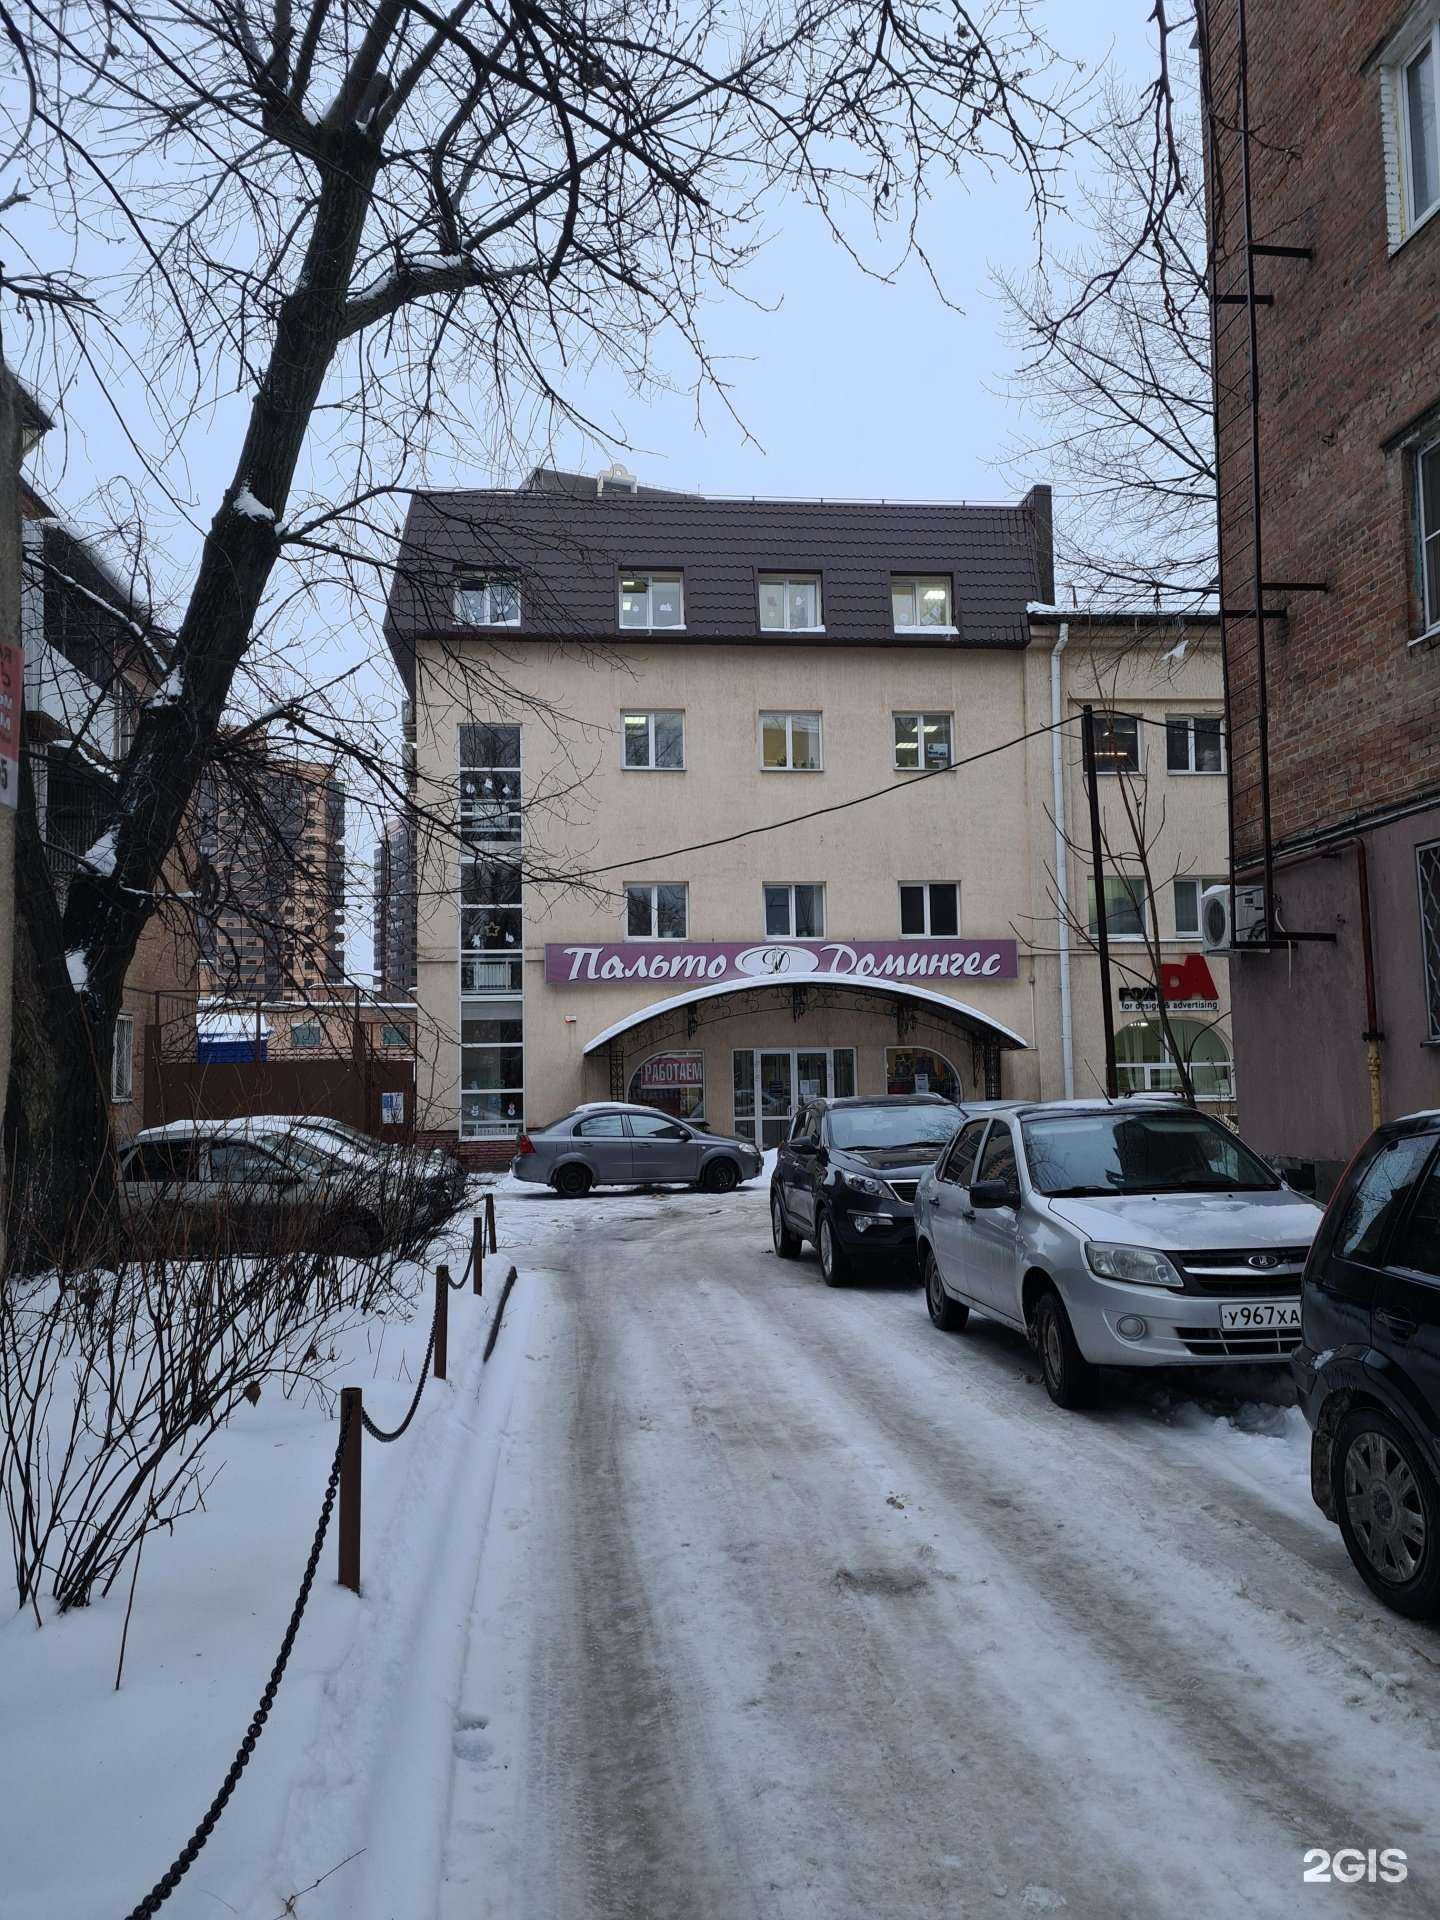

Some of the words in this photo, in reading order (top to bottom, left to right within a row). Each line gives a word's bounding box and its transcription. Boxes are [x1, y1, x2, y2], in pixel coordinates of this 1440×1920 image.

[563, 946, 727, 981] Пальто
[820, 943, 1001, 976] Домингес
[1173, 1000, 1218, 1011] advertising
[644, 1062, 703, 1081] РАБОТАЕМ
